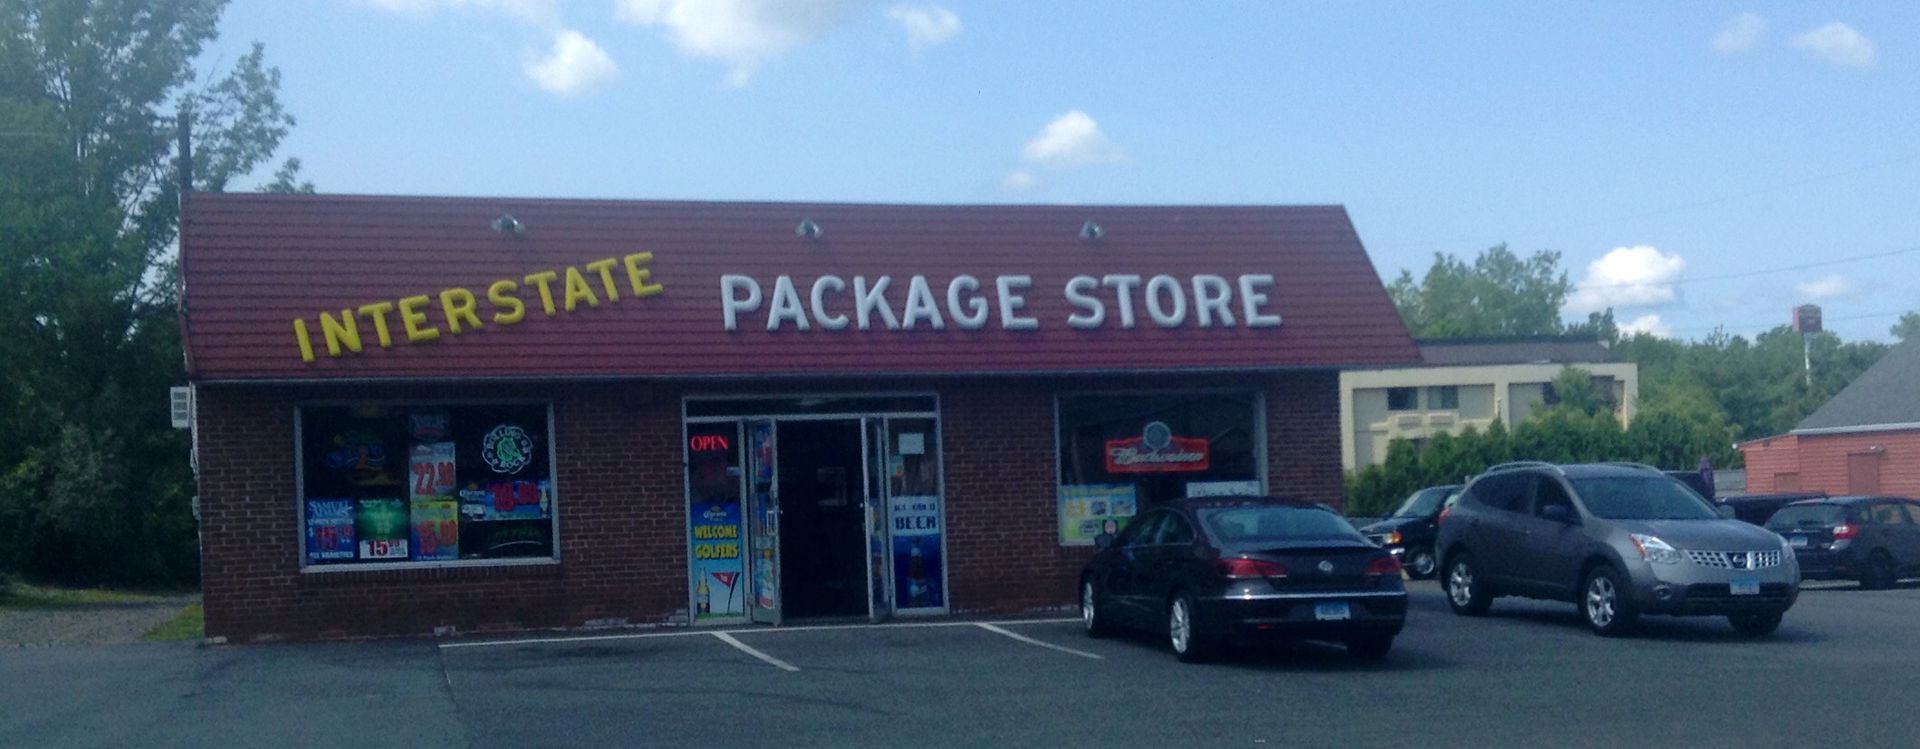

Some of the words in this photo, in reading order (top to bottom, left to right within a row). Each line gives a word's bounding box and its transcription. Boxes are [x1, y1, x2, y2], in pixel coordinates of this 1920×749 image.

[293, 251, 664, 363] INTERSTATE
[719, 274, 1039, 331] PACKAGE
[1065, 273, 1283, 329] STORE
[690, 434, 729, 450] OPEN
[895, 516, 937, 530] BEER
[694, 524, 738, 539] WELCOME
[695, 544, 738, 560] GOLFERS
